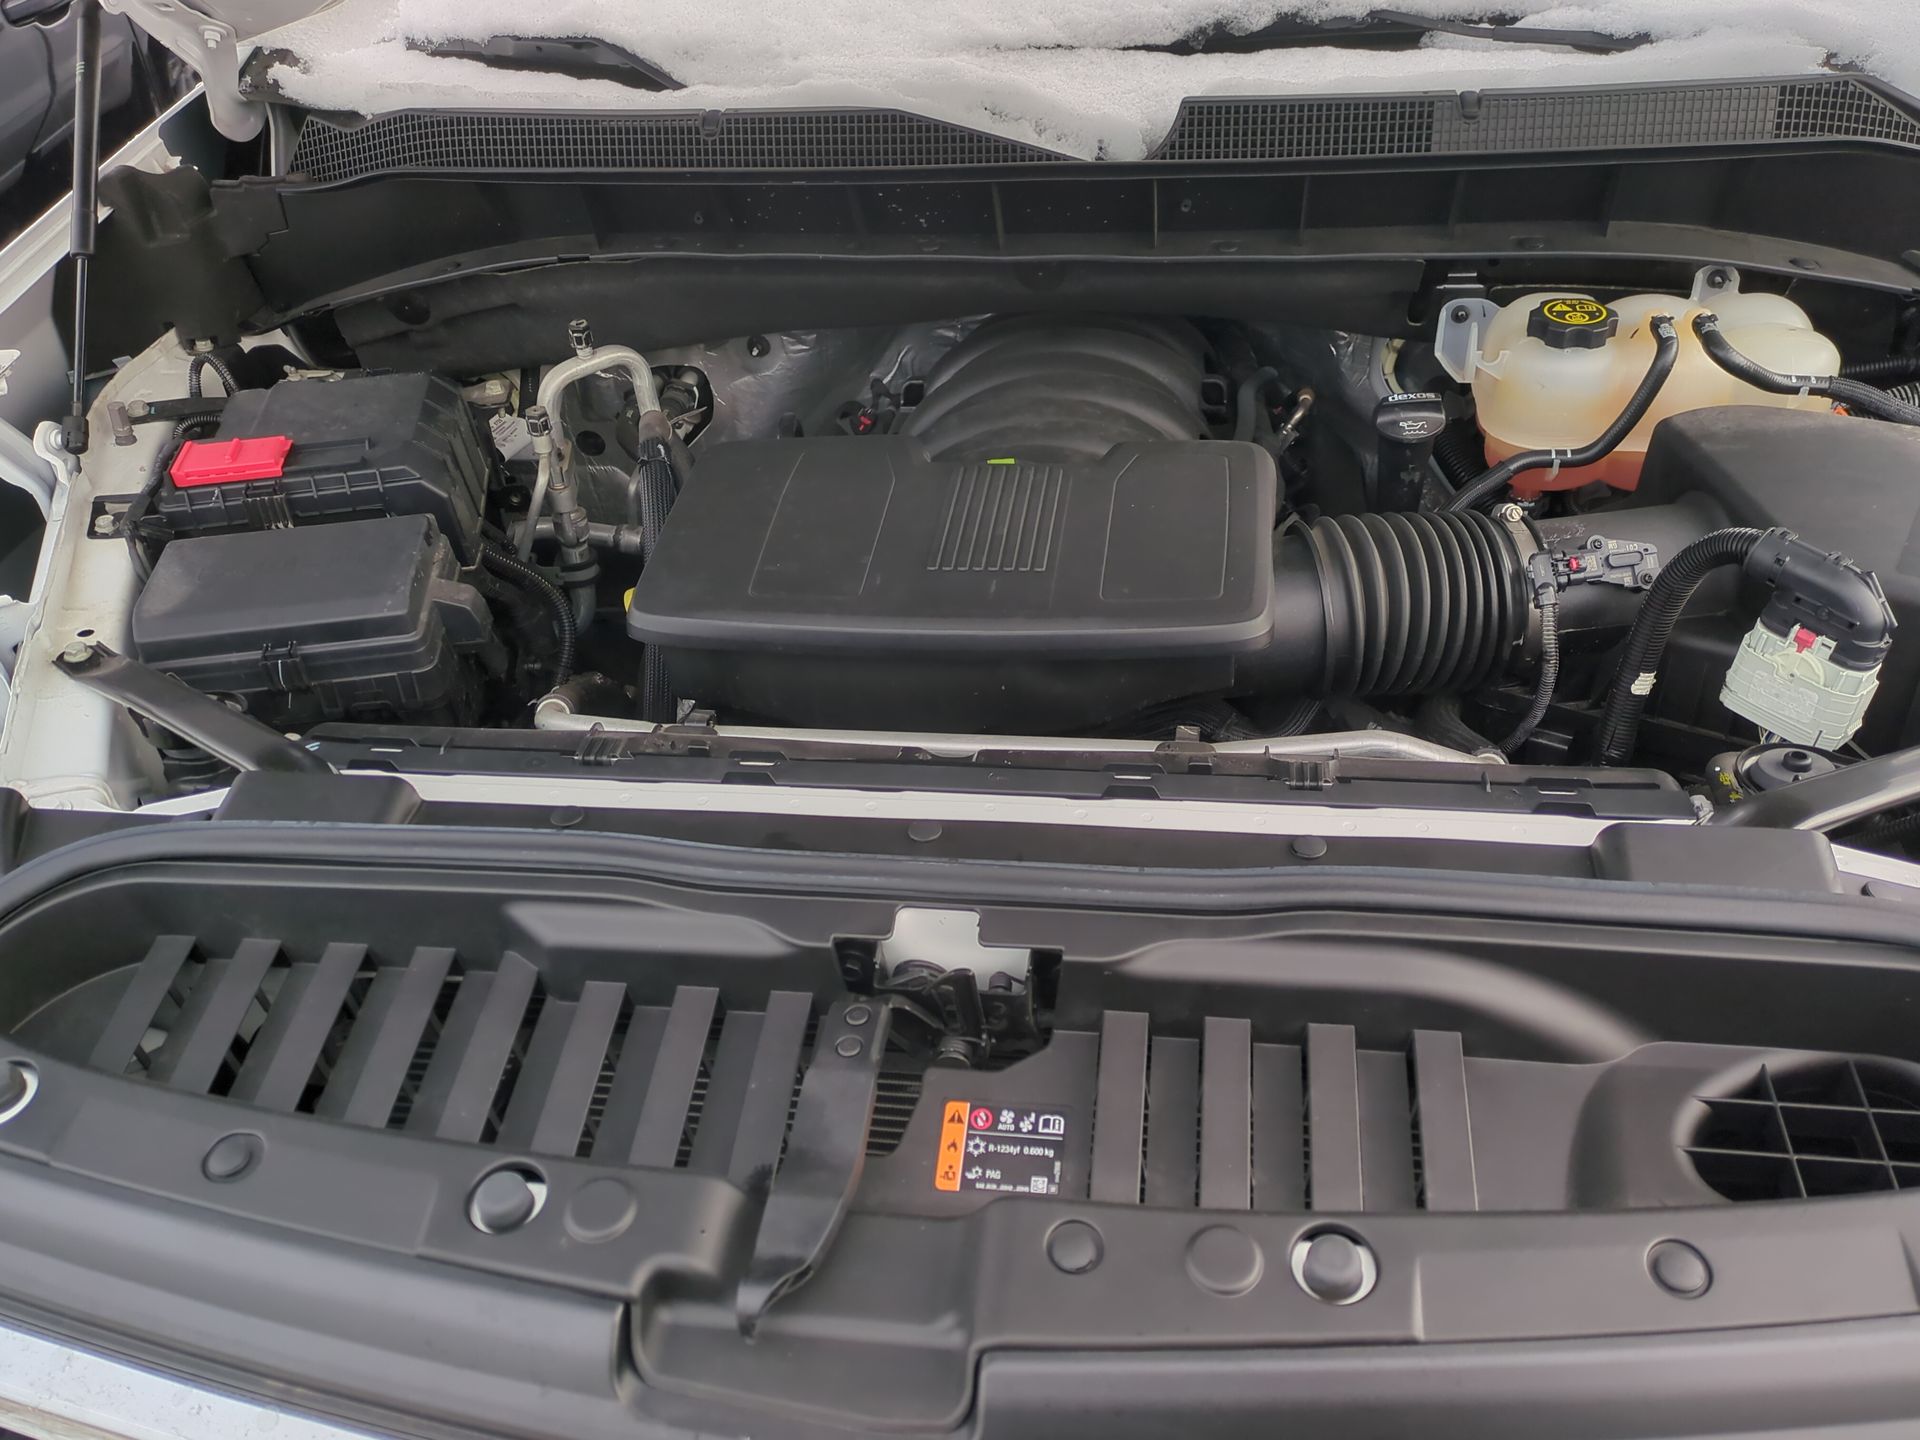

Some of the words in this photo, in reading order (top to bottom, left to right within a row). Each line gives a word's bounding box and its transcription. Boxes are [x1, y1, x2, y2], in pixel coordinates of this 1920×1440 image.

[1388, 393, 1435, 401] dexos
[998, 1123, 1014, 1131] AUTO
[988, 1144, 1020, 1155] R-1234yf
[1045, 1147, 1054, 1158] kg
[986, 1169, 1001, 1179] PAG
